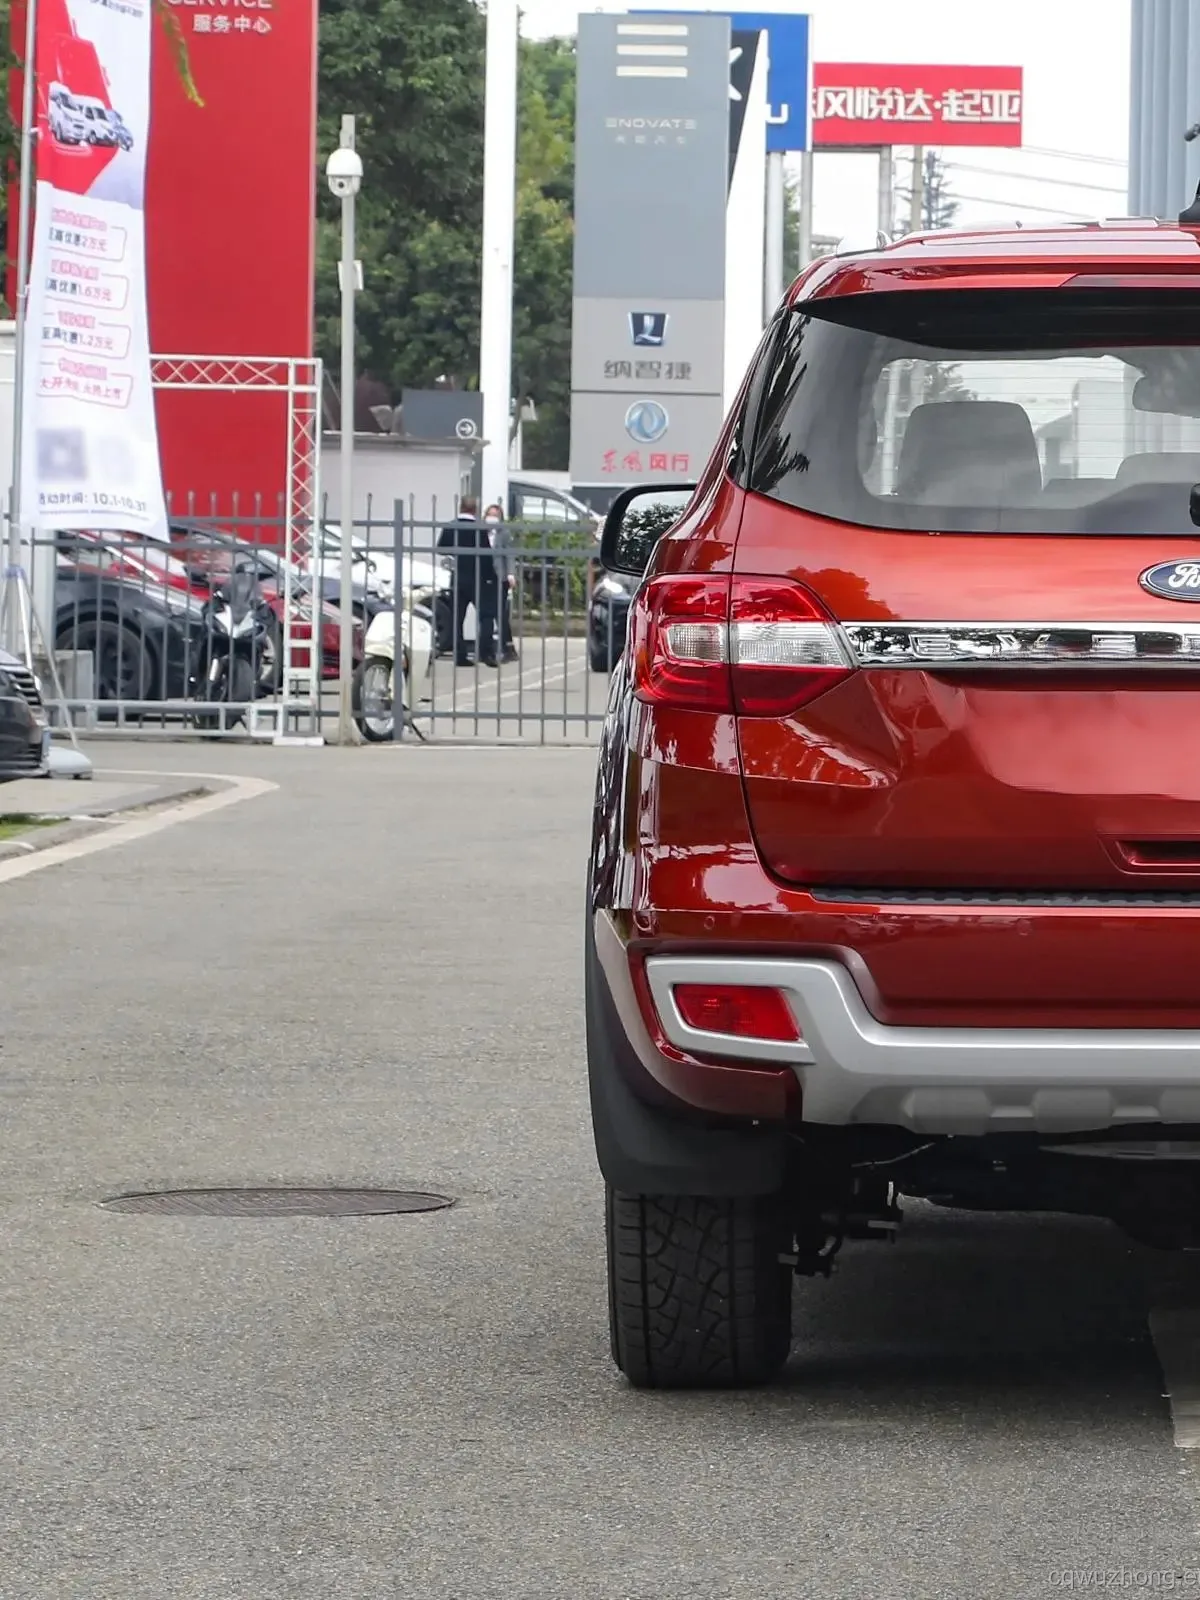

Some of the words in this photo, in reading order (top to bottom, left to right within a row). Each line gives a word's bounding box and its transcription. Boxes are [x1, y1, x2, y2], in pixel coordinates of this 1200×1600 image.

[192, 14, 272, 34] 服务中心
[810, 86, 1021, 123] 风悦达·起亚
[605, 117, 697, 130] ENOVATE
[604, 360, 692, 380] 纳智捷
